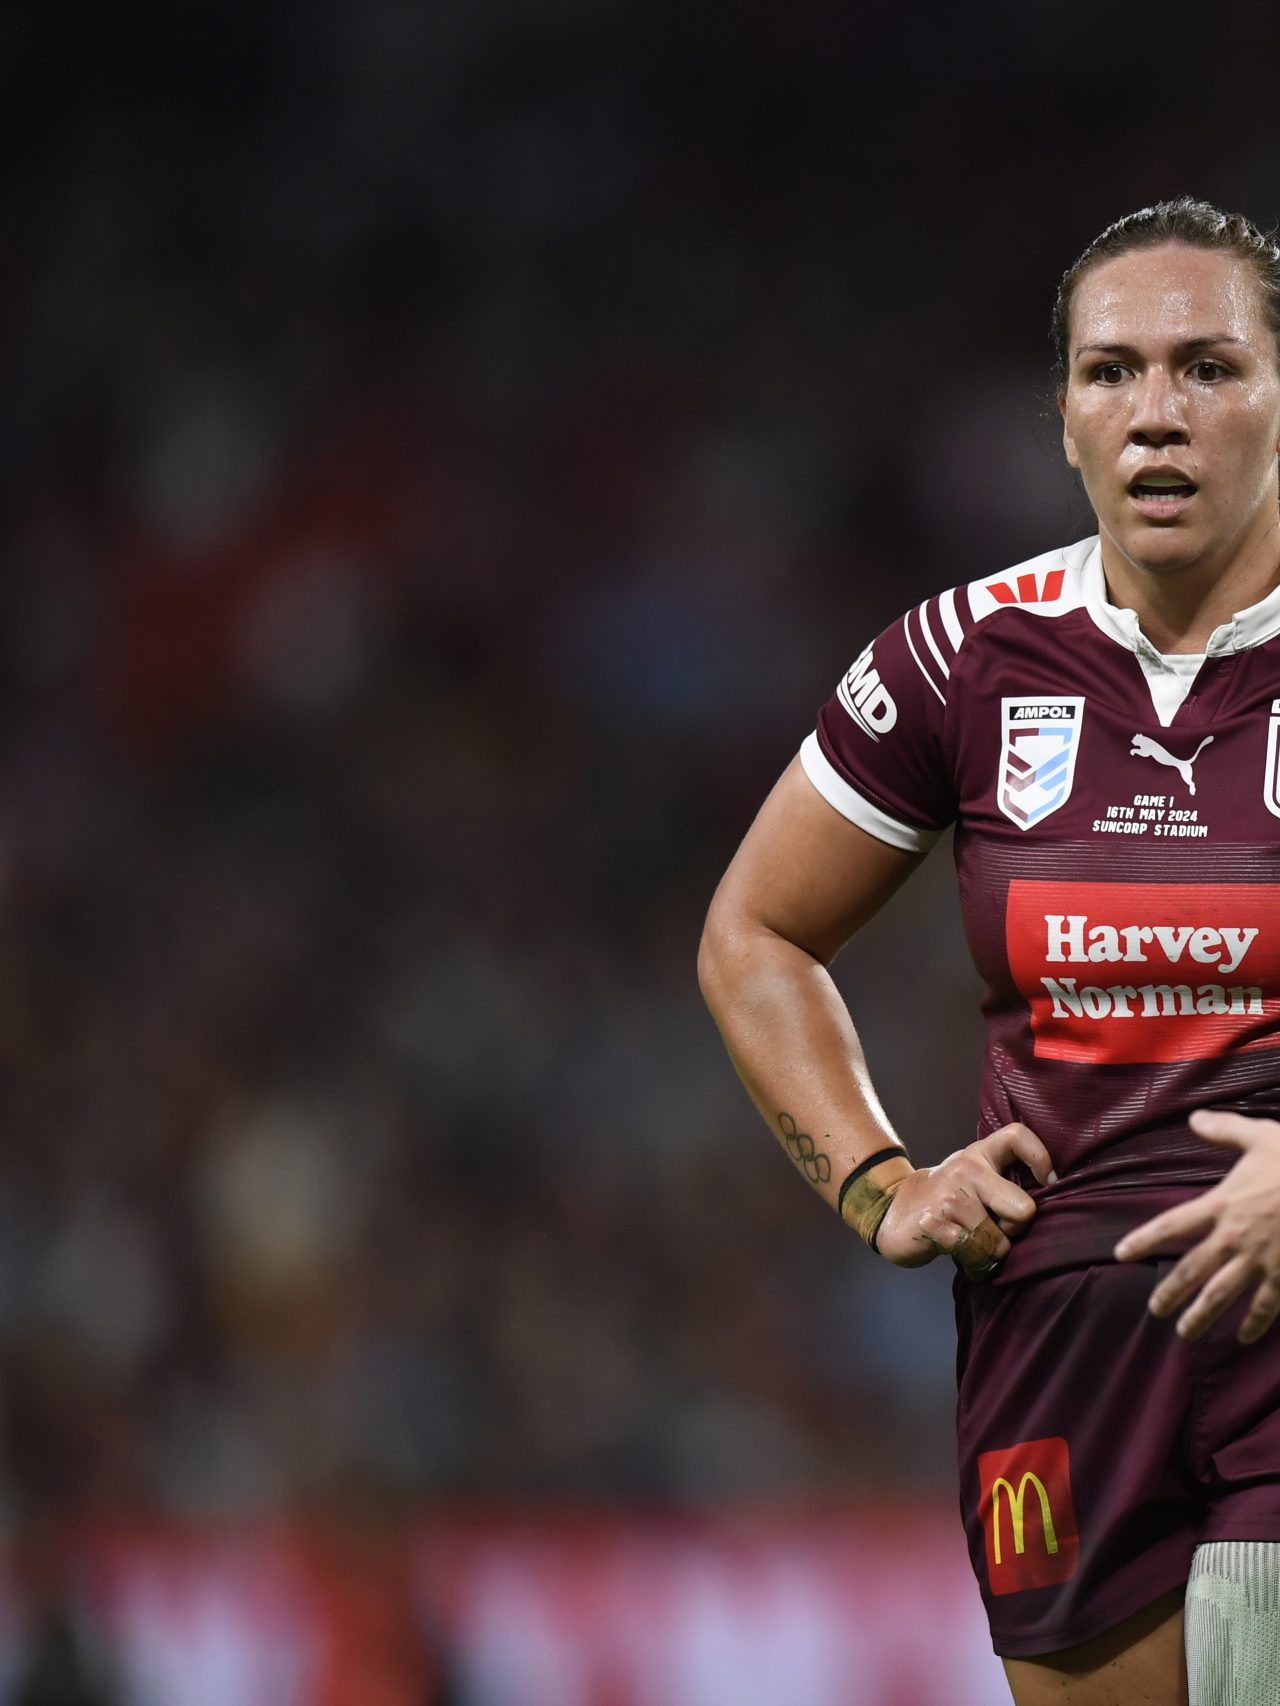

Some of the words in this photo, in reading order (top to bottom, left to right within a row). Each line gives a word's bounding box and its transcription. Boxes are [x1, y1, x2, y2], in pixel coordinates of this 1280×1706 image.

[1013, 706, 1072, 719] AMPOL
[1133, 794, 1167, 808] GAME
[1106, 806, 1135, 819] 16TH
[1138, 808, 1166, 821] MAY
[1167, 810, 1199, 822] 2024
[1092, 820, 1148, 835] SUNCORP
[1153, 824, 1209, 838] STADIUM
[1044, 914, 1259, 974] Harvey
[1040, 977, 1264, 1020] Norman
